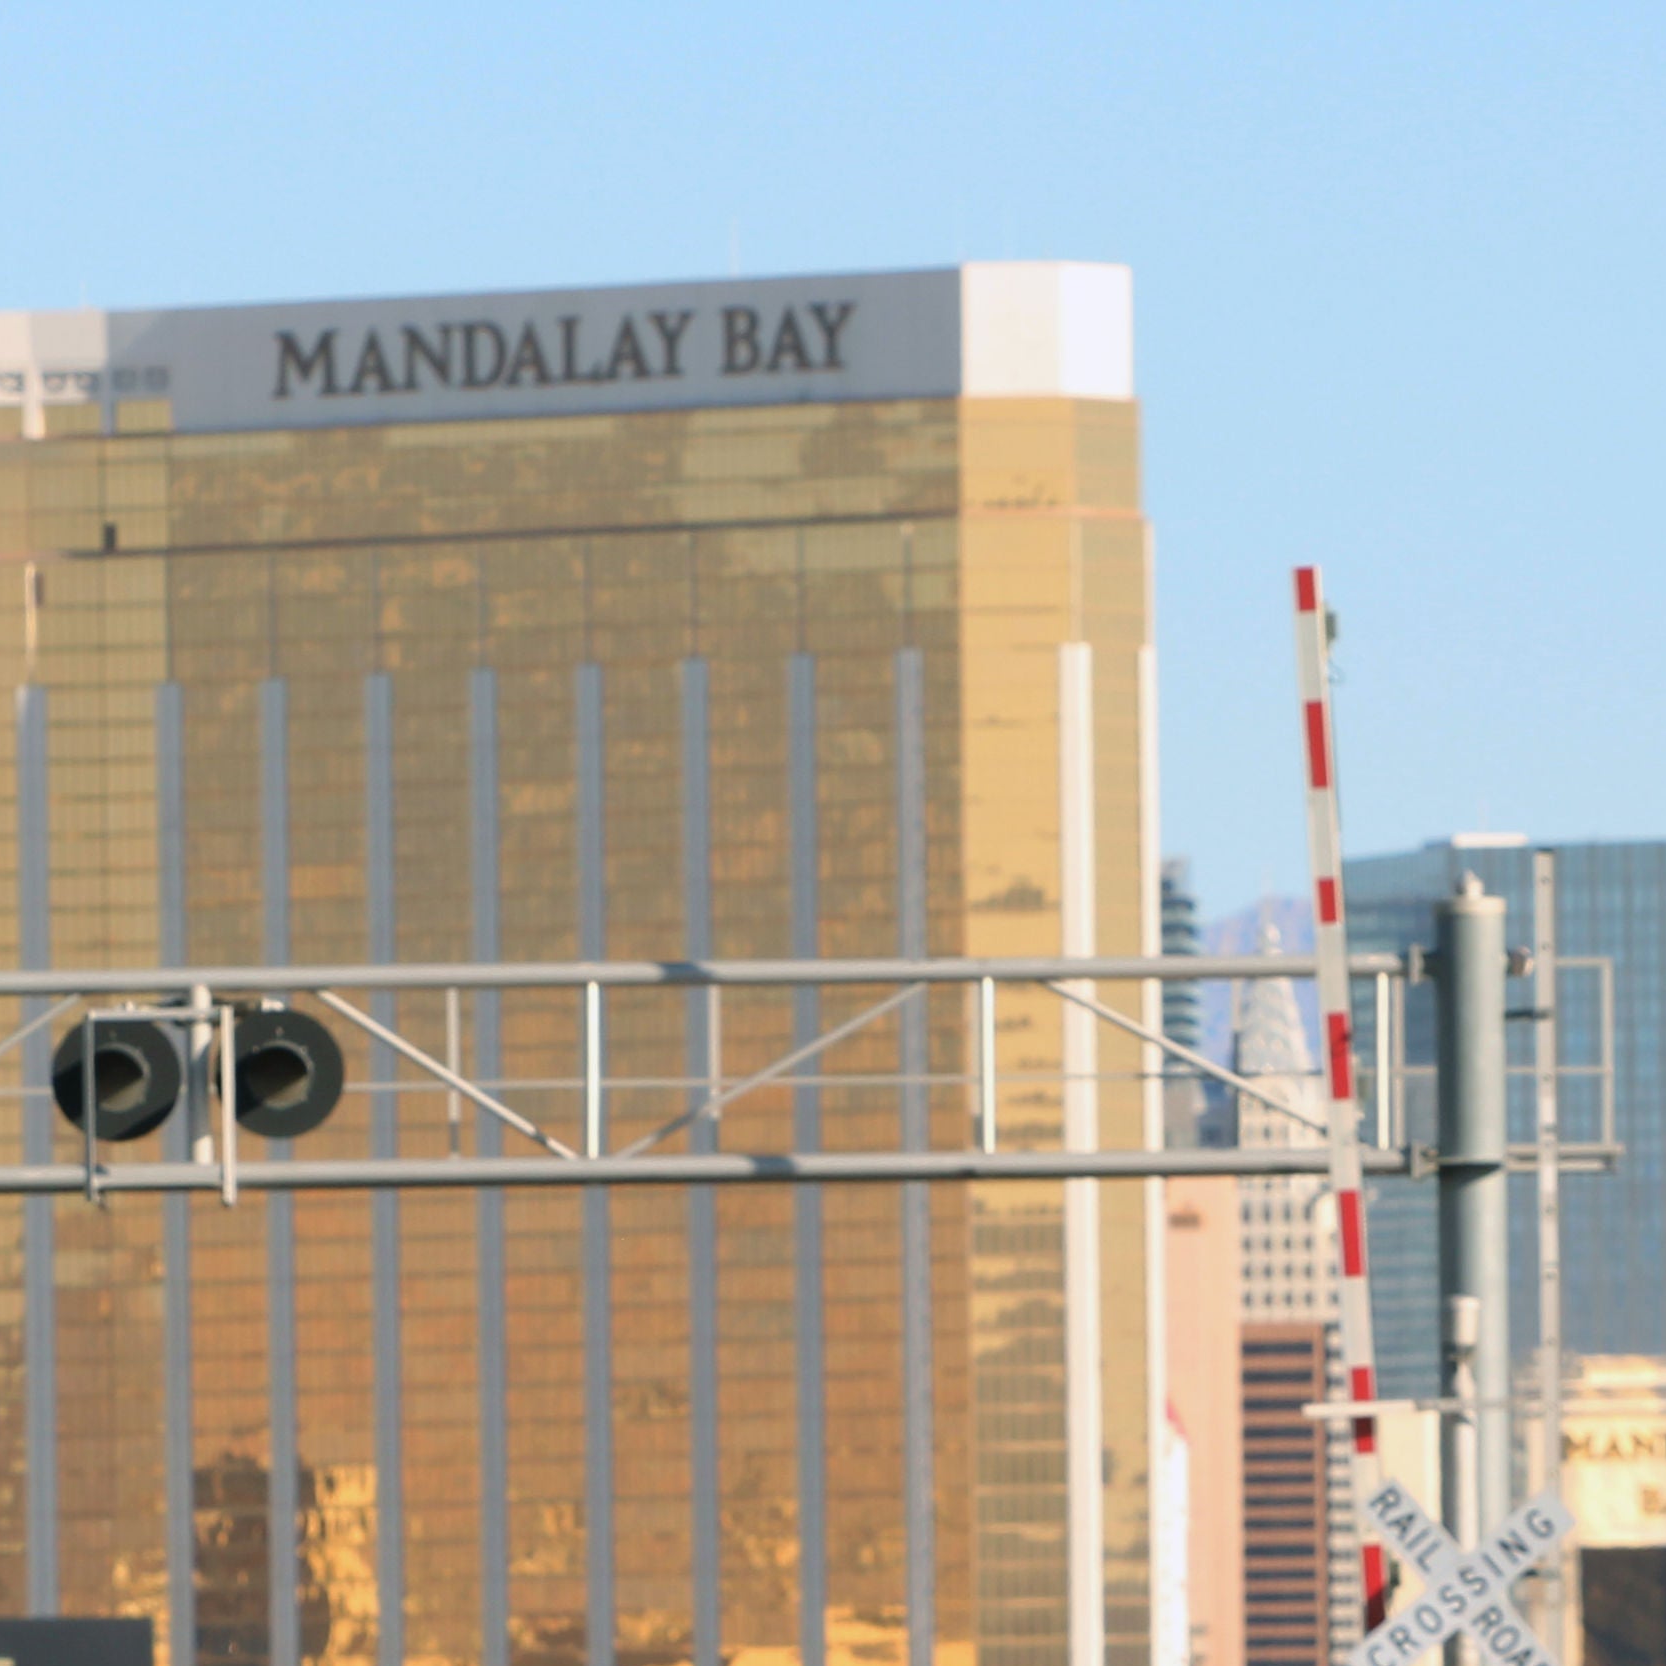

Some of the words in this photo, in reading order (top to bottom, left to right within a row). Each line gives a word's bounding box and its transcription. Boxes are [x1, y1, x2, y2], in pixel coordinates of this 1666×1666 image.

[273, 307, 695, 398] MANDALAY
[718, 299, 858, 376] BAY
[1370, 1486, 1443, 1573] RAIL
